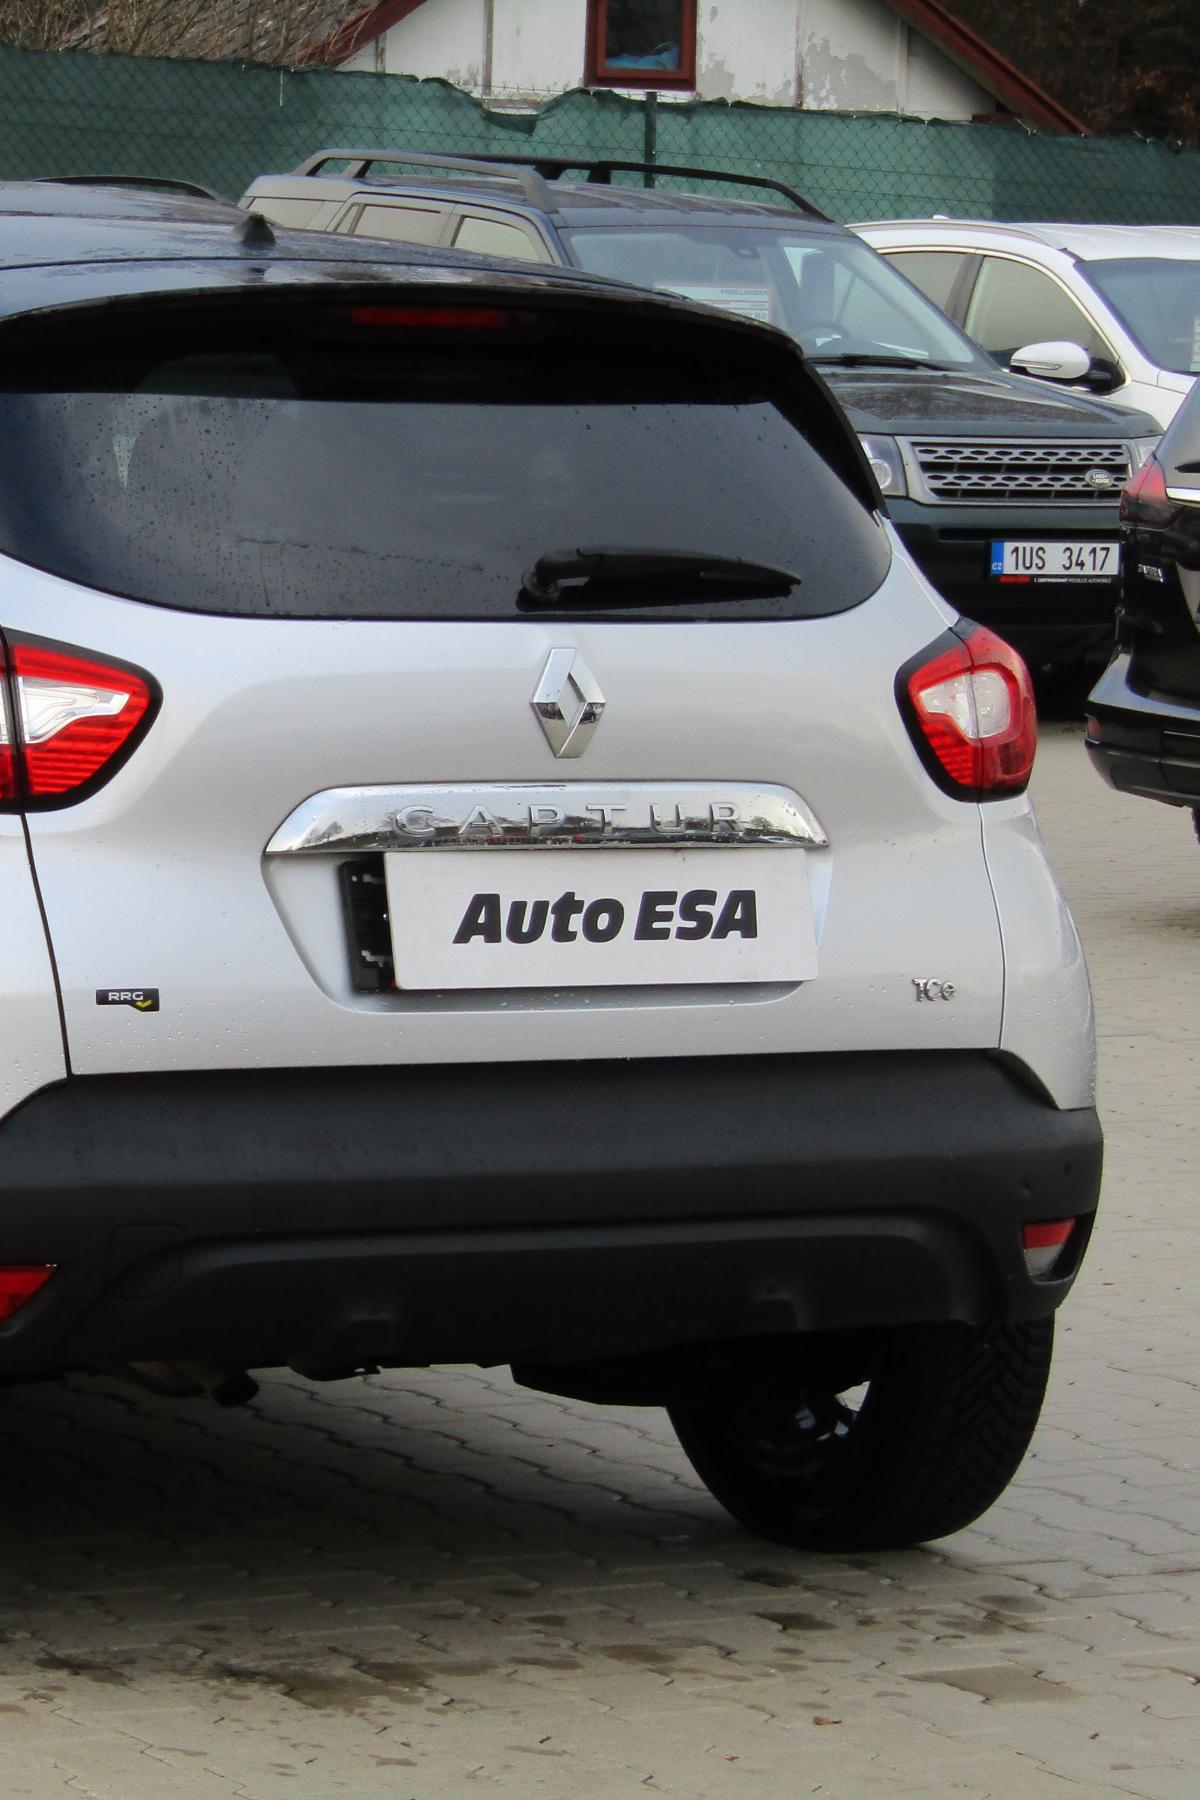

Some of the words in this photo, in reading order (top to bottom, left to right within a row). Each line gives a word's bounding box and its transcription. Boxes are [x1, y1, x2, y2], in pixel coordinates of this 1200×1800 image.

[992, 562, 1003, 570] CZ
[1010, 546, 1046, 571] 1US
[1061, 546, 1111, 572] 3417
[396, 800, 745, 838] CAPTUR
[452, 890, 624, 945] Auto
[633, 888, 758, 941] ESA
[108, 991, 144, 1001] RRG
